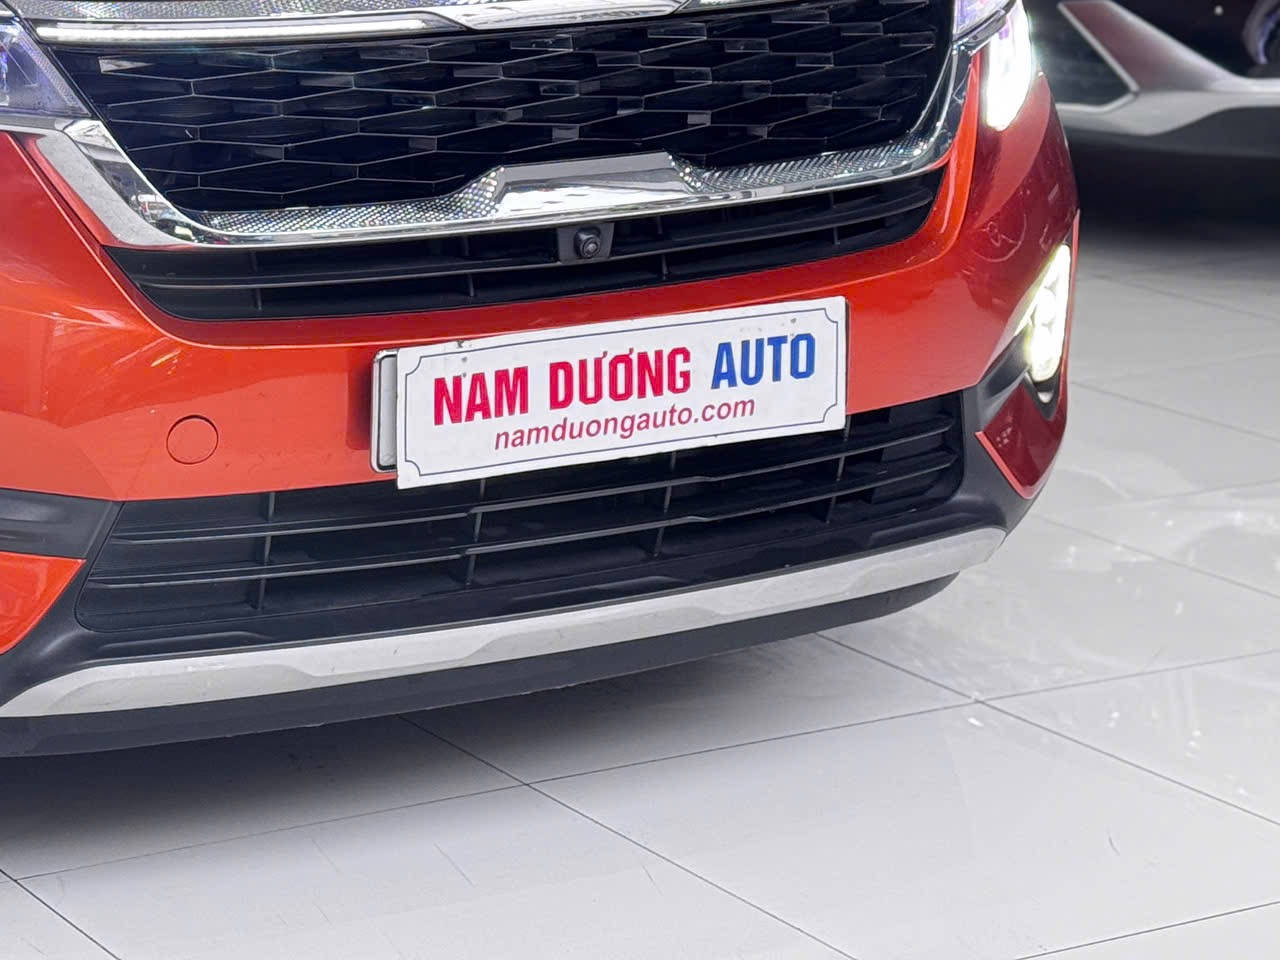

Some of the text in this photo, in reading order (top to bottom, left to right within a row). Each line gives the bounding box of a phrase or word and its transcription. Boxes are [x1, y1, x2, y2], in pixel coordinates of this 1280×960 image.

[432, 332, 817, 426] NAM DƯƠNG AUTO
[493, 397, 756, 451] namduongauto.com
